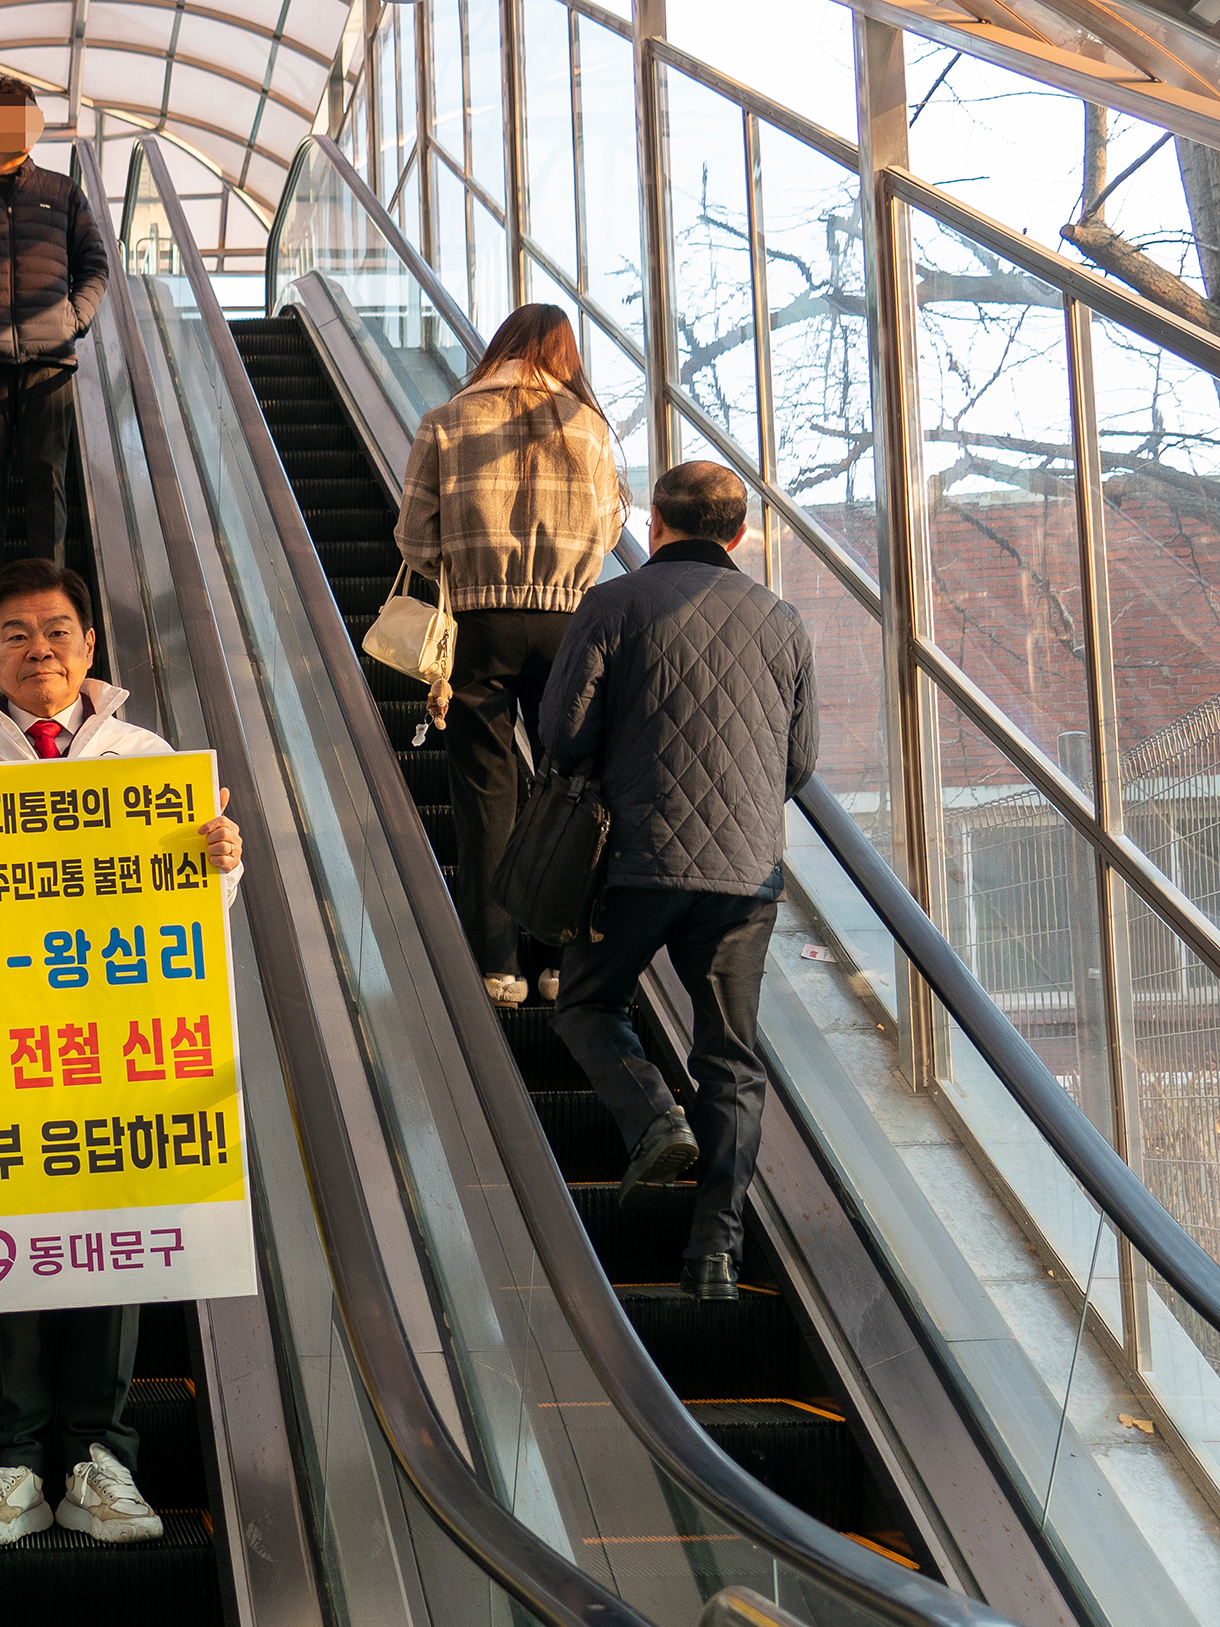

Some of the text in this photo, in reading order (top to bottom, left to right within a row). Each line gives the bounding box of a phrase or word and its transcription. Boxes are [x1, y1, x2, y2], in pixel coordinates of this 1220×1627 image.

[124, 784, 194, 825] 약속!
[94, 856, 142, 895] 불편
[151, 852, 206, 891] 해소!
[10, 1022, 101, 1089] 전철
[123, 1015, 213, 1082] 신설
[42, 1111, 227, 1176] 응답하라!
[30, 1228, 184, 1276] 동대문구
